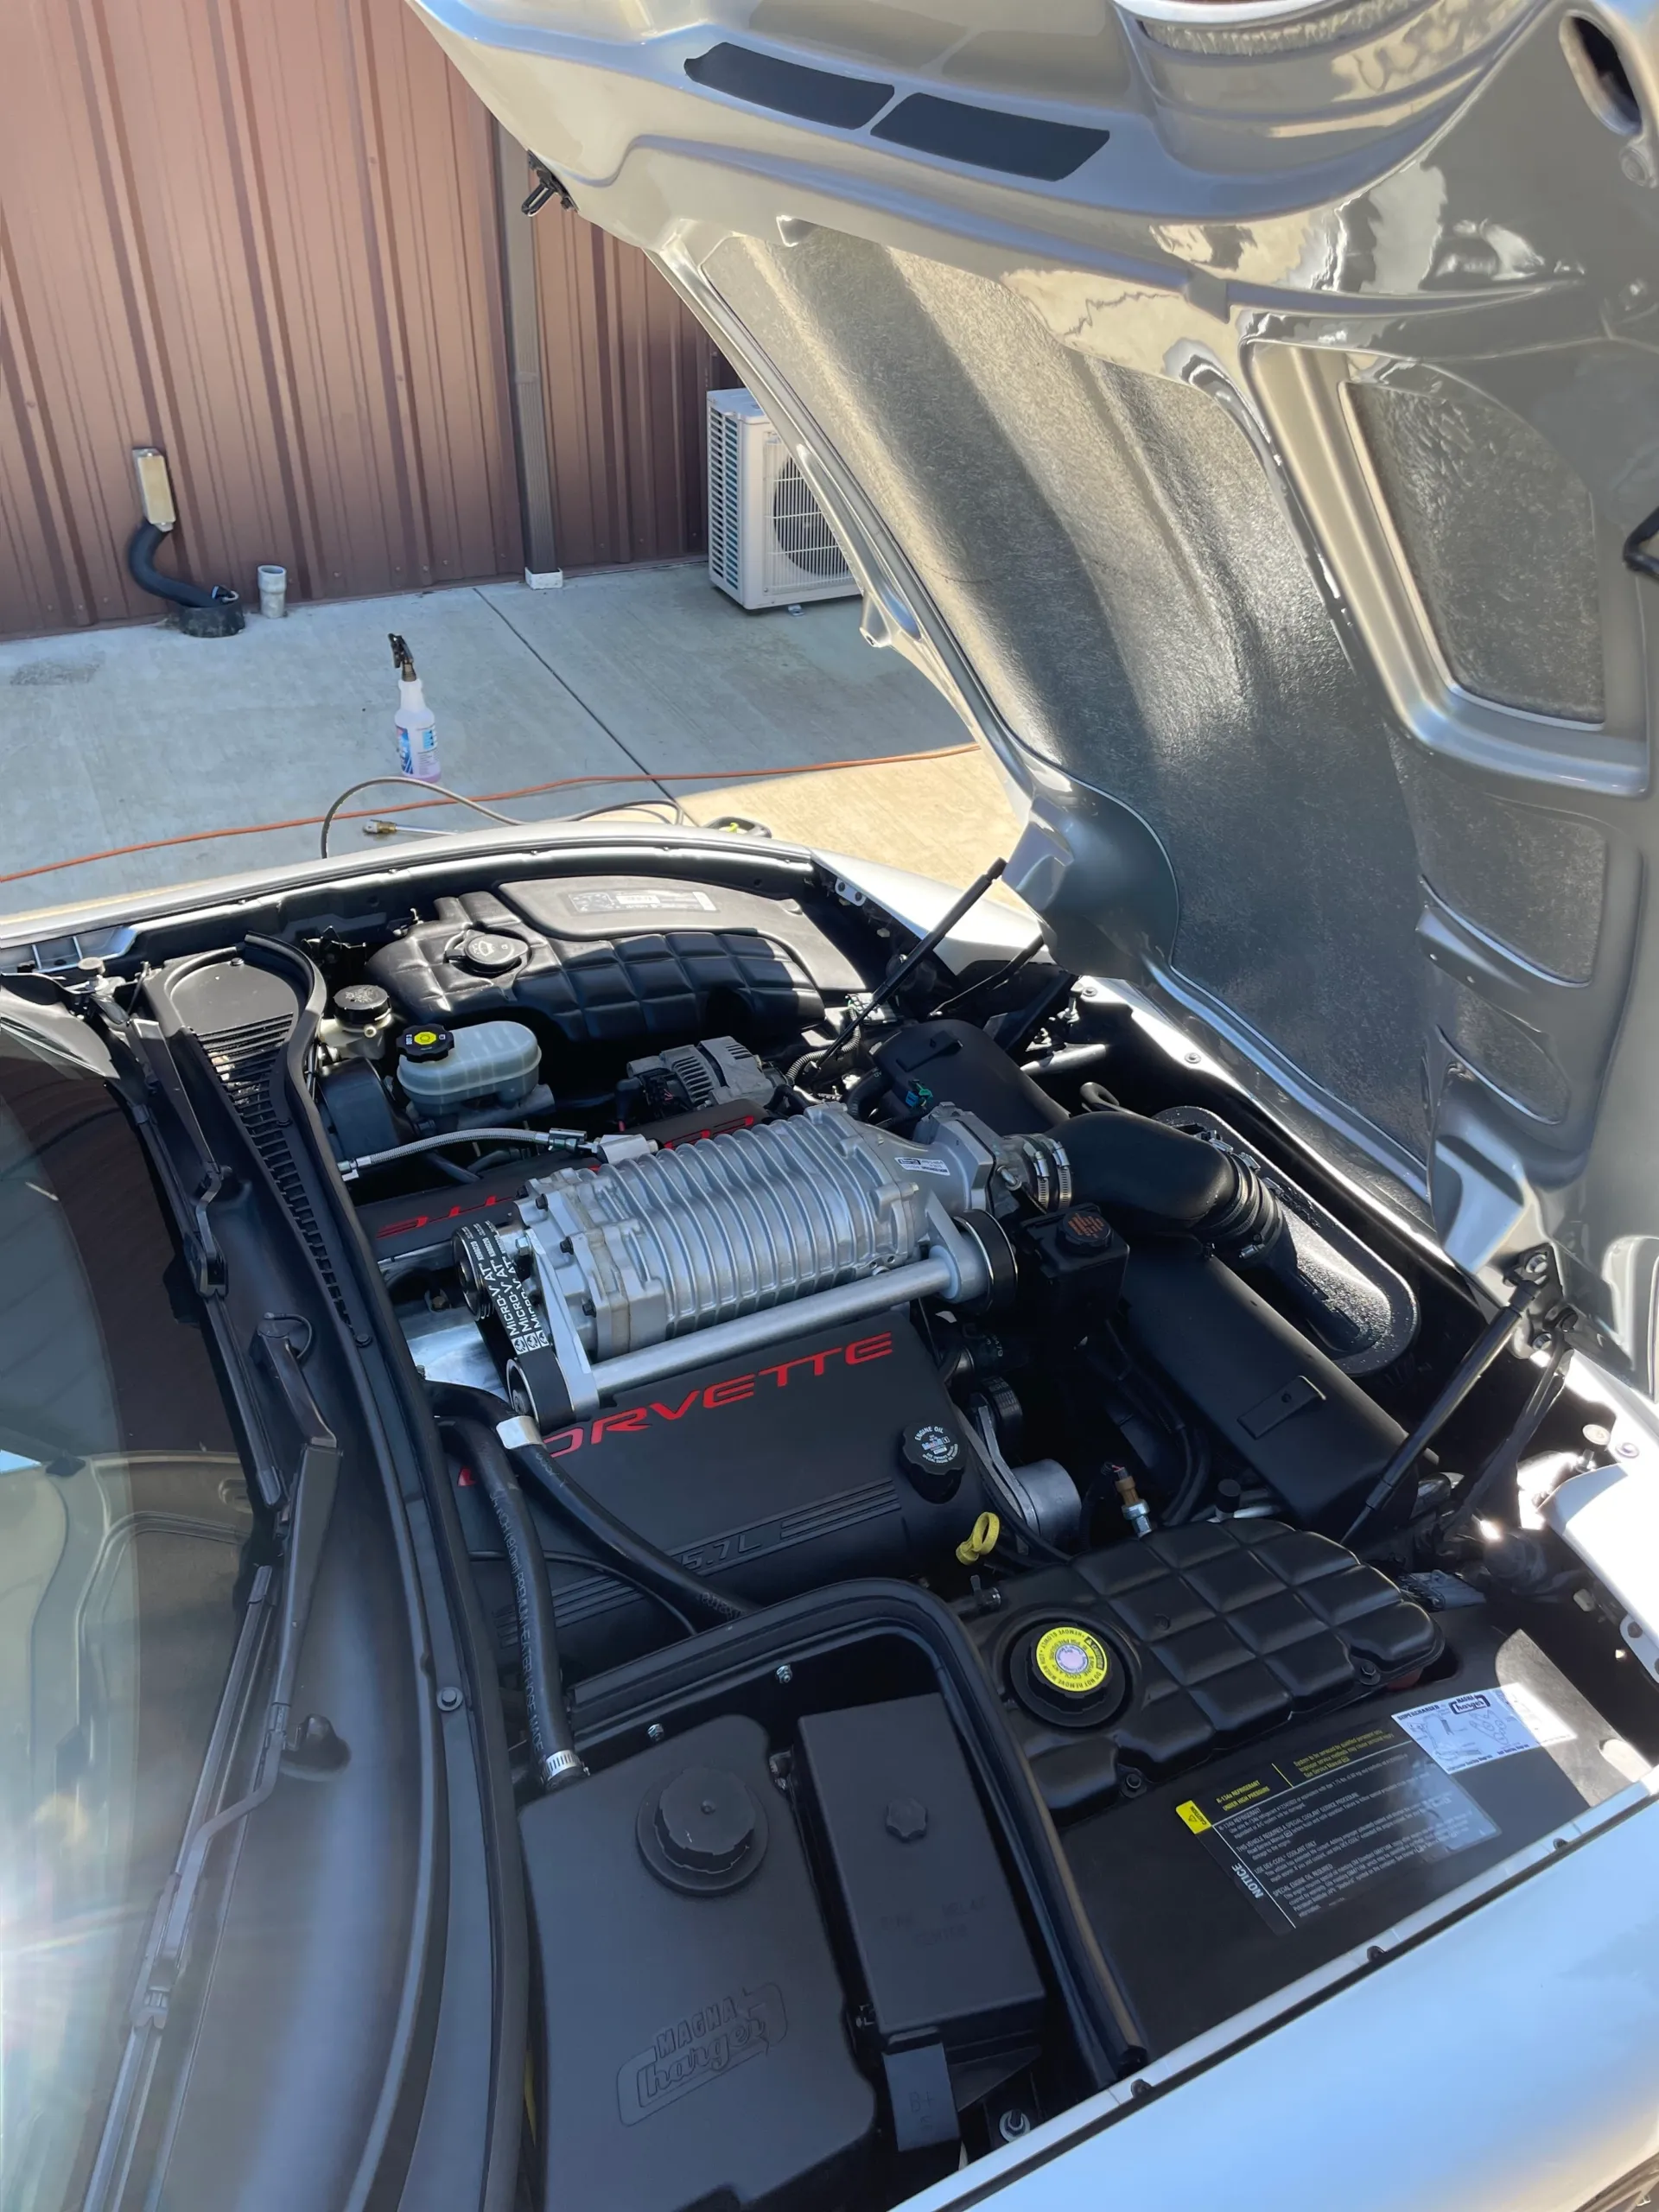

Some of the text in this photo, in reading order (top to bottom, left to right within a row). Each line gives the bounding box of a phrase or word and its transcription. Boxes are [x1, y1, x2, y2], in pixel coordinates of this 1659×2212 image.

[914, 1426, 932, 1440] ENGINE
[681, 1534, 764, 1571] 5.7L
[520, 1625, 533, 1673] HEATER
[524, 1675, 537, 1715] HOSE
[1058, 1679, 1082, 1688] REMOVE
[1221, 1800, 1239, 1810] UNDER
[1246, 1786, 1271, 1799] PRESSURE
[1229, 1779, 1262, 1796] REFRIGERANT
[1244, 1835, 1264, 1847] VEHICLE
[1261, 1826, 1284, 1839] REQUIRES
[1284, 1817, 1303, 1828] SPECIAL
[1300, 1808, 1321, 1821] COOLANT
[1253, 1866, 1264, 1874] USE
[1285, 1845, 1306, 1858] COOLANT
[1230, 1862, 1264, 1898] NOTICE
[1271, 1885, 1291, 1897] SPECIAL
[1288, 1877, 1306, 1888] ENGINE
[1310, 1863, 1334, 1877] REQUIRED
[656, 1996, 738, 2058] MAGNA
[909, 2091, 936, 2113] B+
